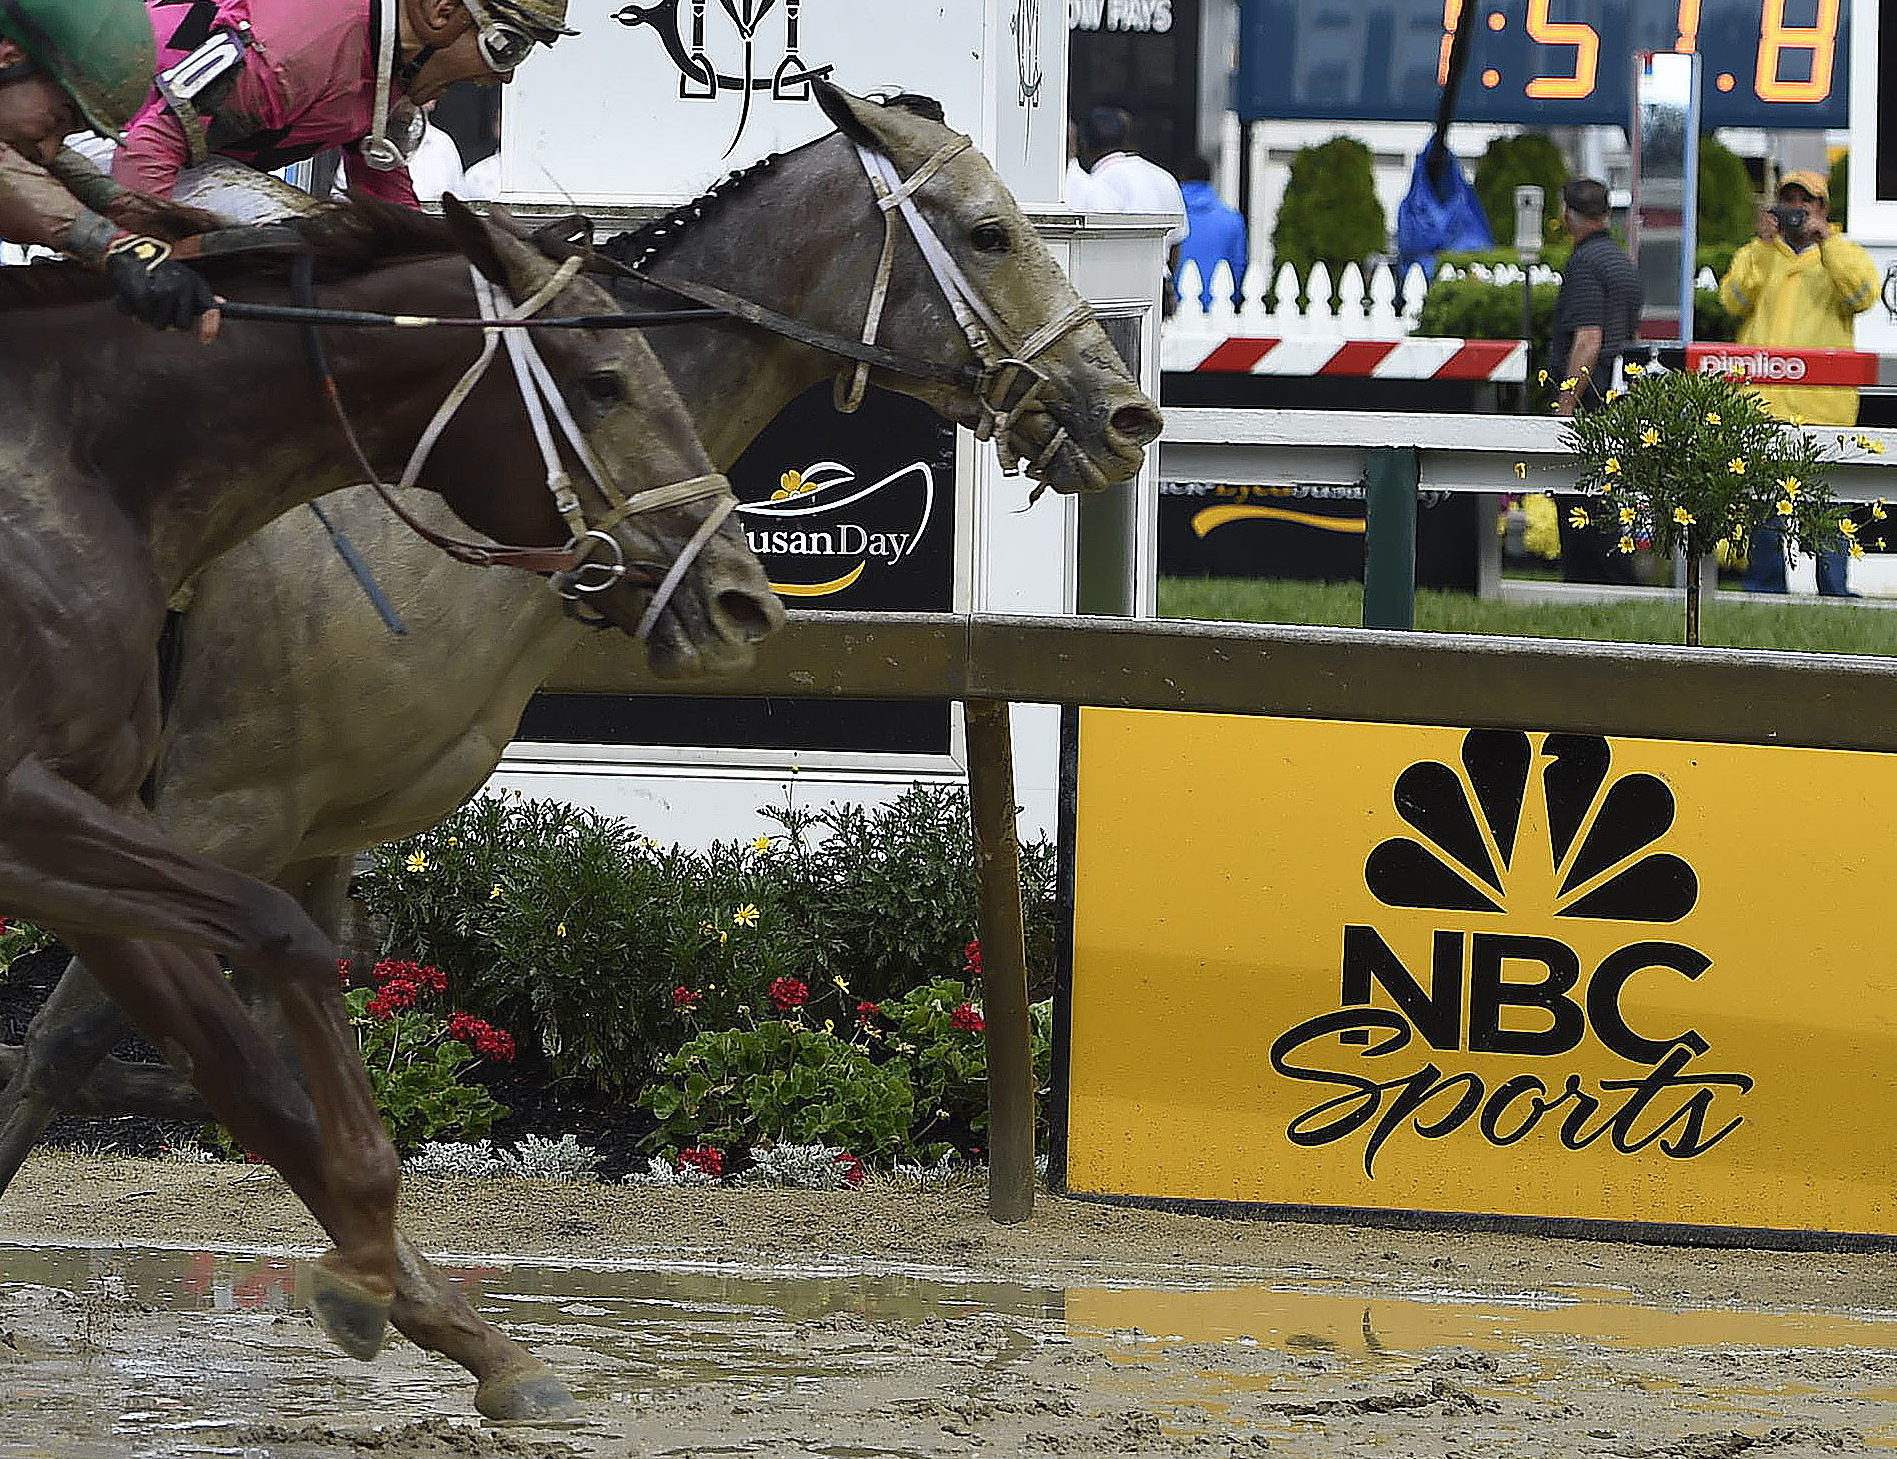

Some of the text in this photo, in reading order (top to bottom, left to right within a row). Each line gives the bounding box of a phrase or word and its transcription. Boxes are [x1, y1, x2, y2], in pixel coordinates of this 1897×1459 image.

[1699, 350, 1807, 381] pimlico
[740, 522, 911, 567] usanDay
[1340, 923, 1713, 1067] NBC
[1269, 1007, 1755, 1180] Sports
